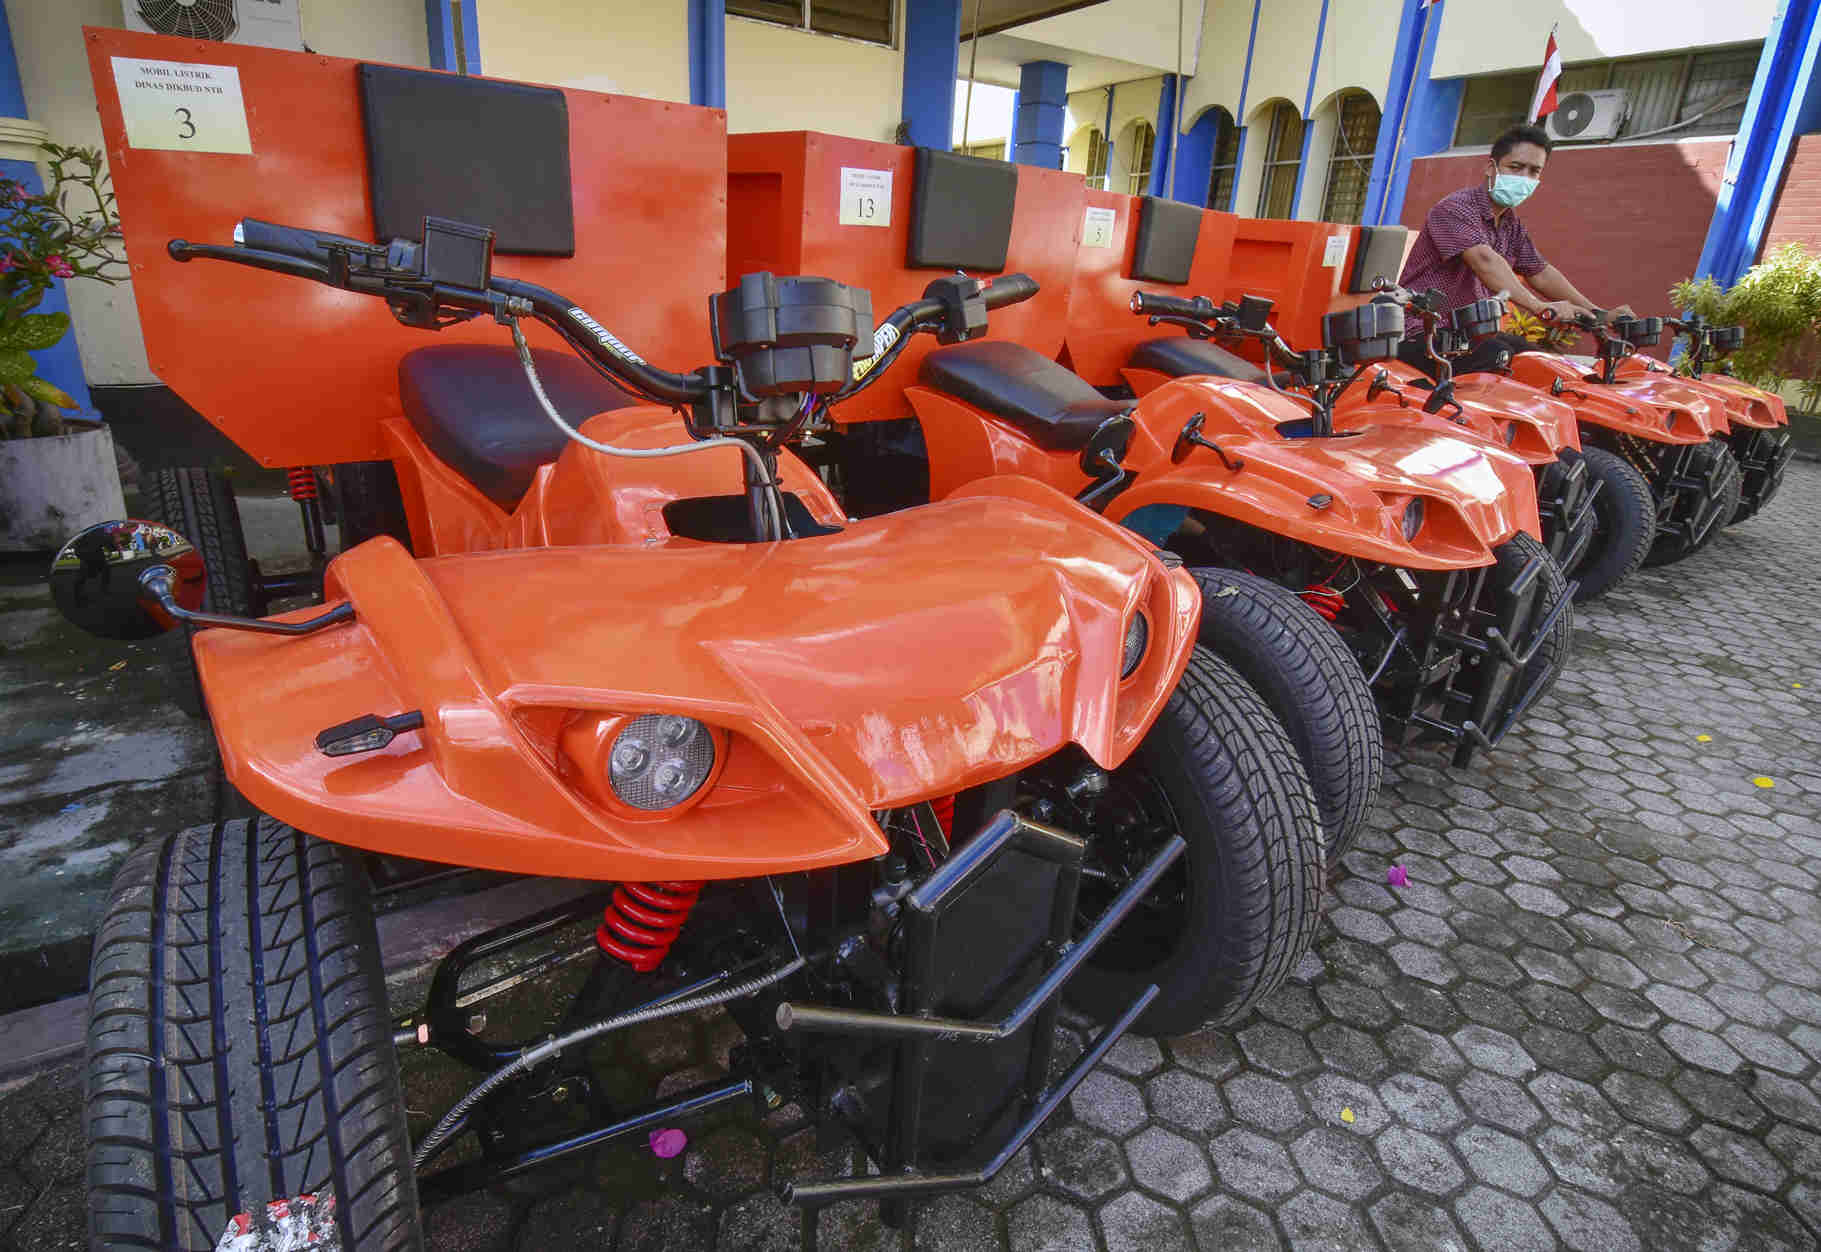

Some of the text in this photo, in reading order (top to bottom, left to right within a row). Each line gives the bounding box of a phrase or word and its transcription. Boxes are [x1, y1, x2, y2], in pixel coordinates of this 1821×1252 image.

[139, 66, 212, 80] MOBIL LISTRIK
[135, 80, 164, 90] DINAS
[166, 82, 203, 93] DIKBUD
[175, 107, 196, 139] 3
[857, 198, 875, 218] 13
